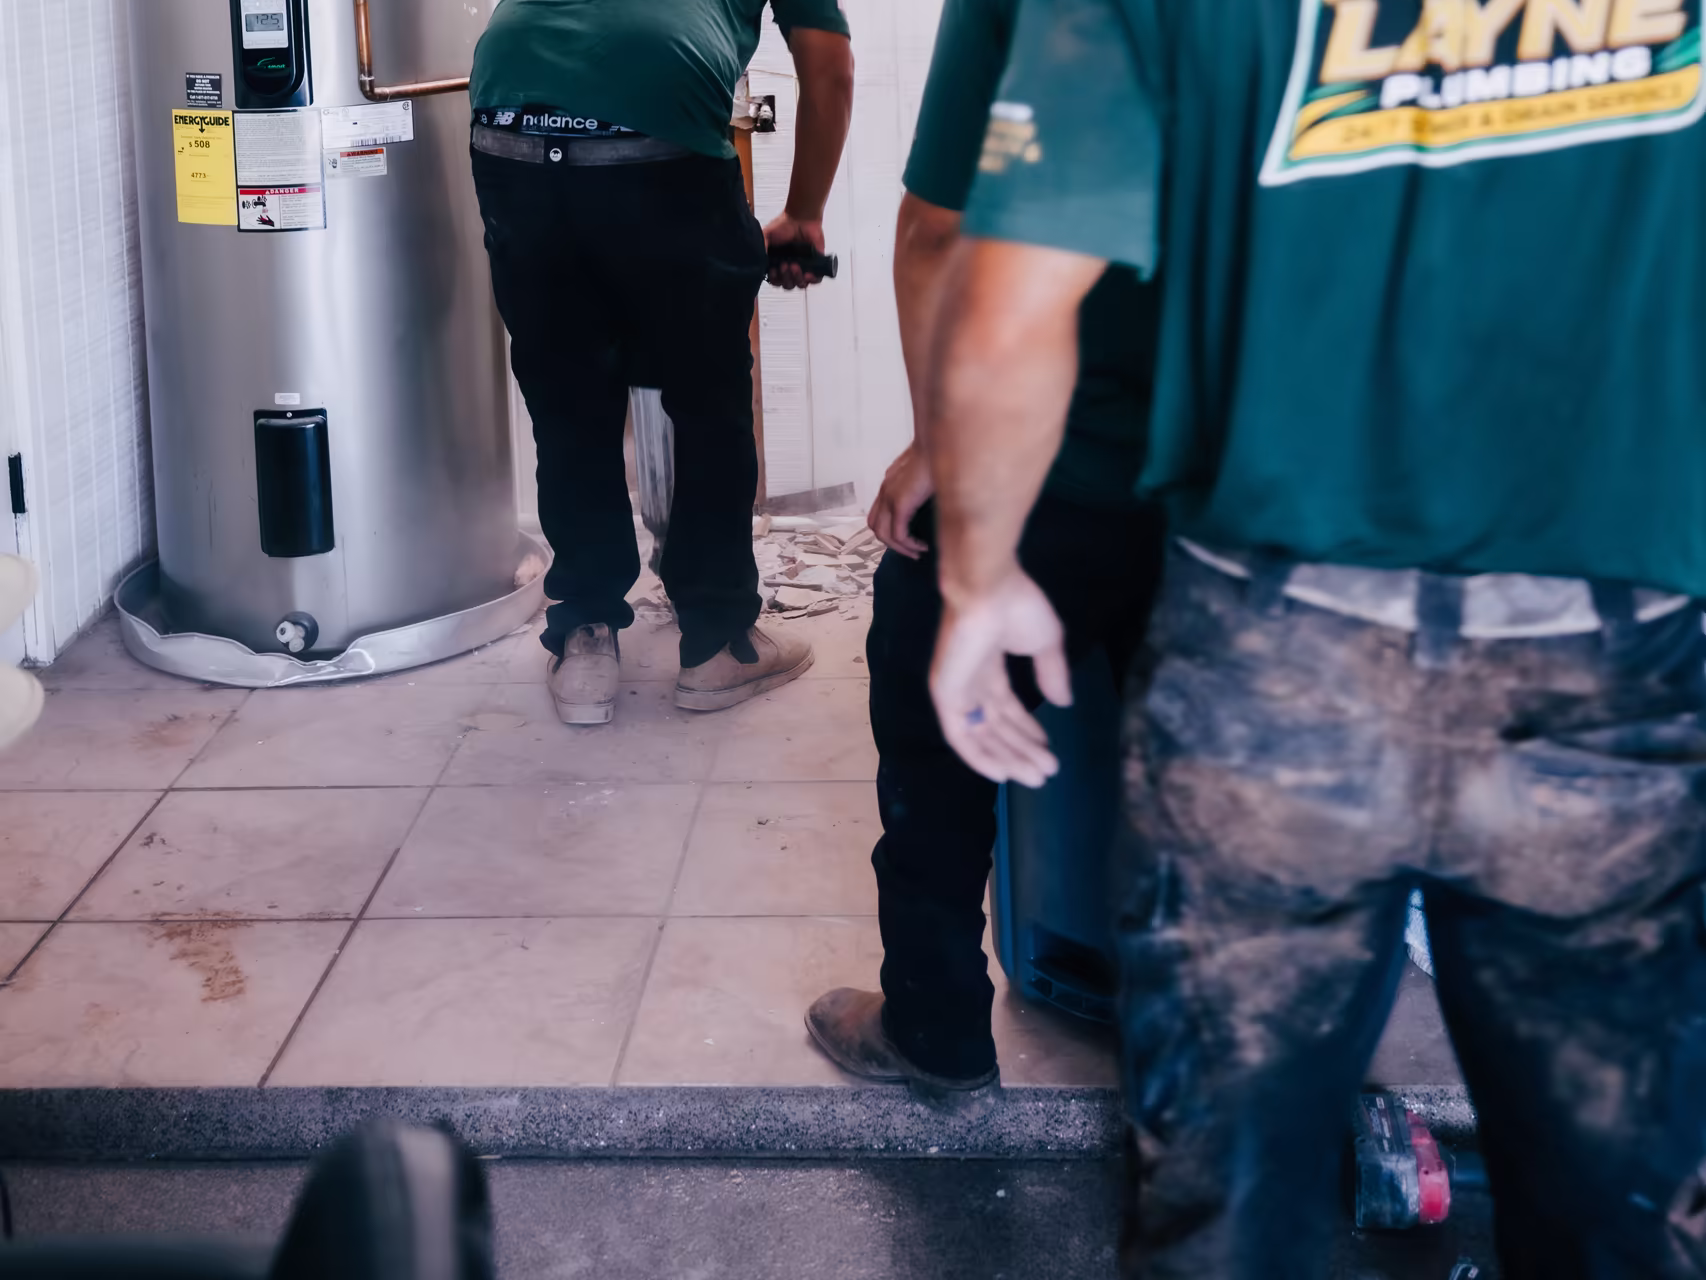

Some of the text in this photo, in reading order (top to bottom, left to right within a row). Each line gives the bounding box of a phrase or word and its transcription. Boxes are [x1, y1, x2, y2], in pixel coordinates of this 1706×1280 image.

[256, 14, 279, 25] 125
[1380, 46, 1651, 109] PLUMBING
[174, 114, 230, 126] ENERGYGUIDE
[194, 140, 210, 148] 508
